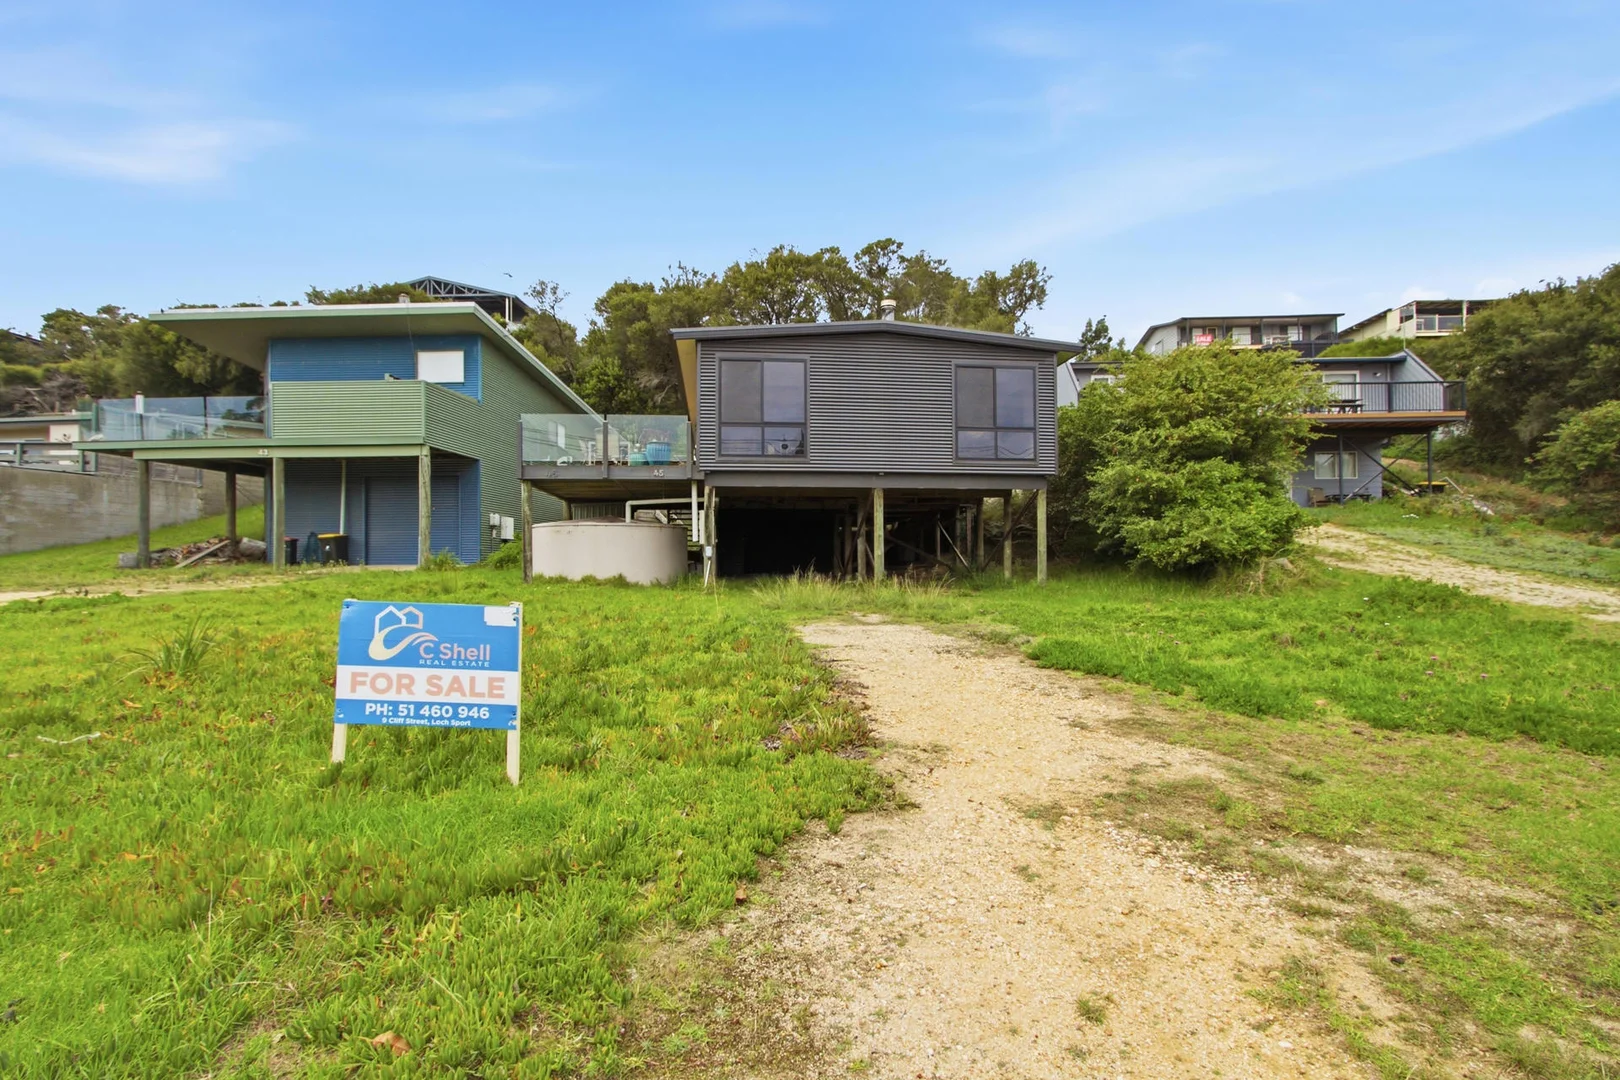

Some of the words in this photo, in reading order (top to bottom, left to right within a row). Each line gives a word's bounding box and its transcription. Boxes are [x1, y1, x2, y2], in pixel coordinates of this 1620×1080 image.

[653, 469, 664, 477] 45
[419, 642, 434, 659] C
[439, 642, 491, 661] Shell
[451, 660, 490, 668] ESTATE
[350, 671, 415, 696] FOR
[425, 674, 505, 699] SALE
[365, 702, 393, 716] PH:
[398, 703, 414, 717] 51
[420, 704, 453, 718] 460
[458, 706, 490, 719] 946
[405, 718, 430, 726] Street,
[431, 718, 449, 726] Loch
[450, 719, 471, 727] Sport
